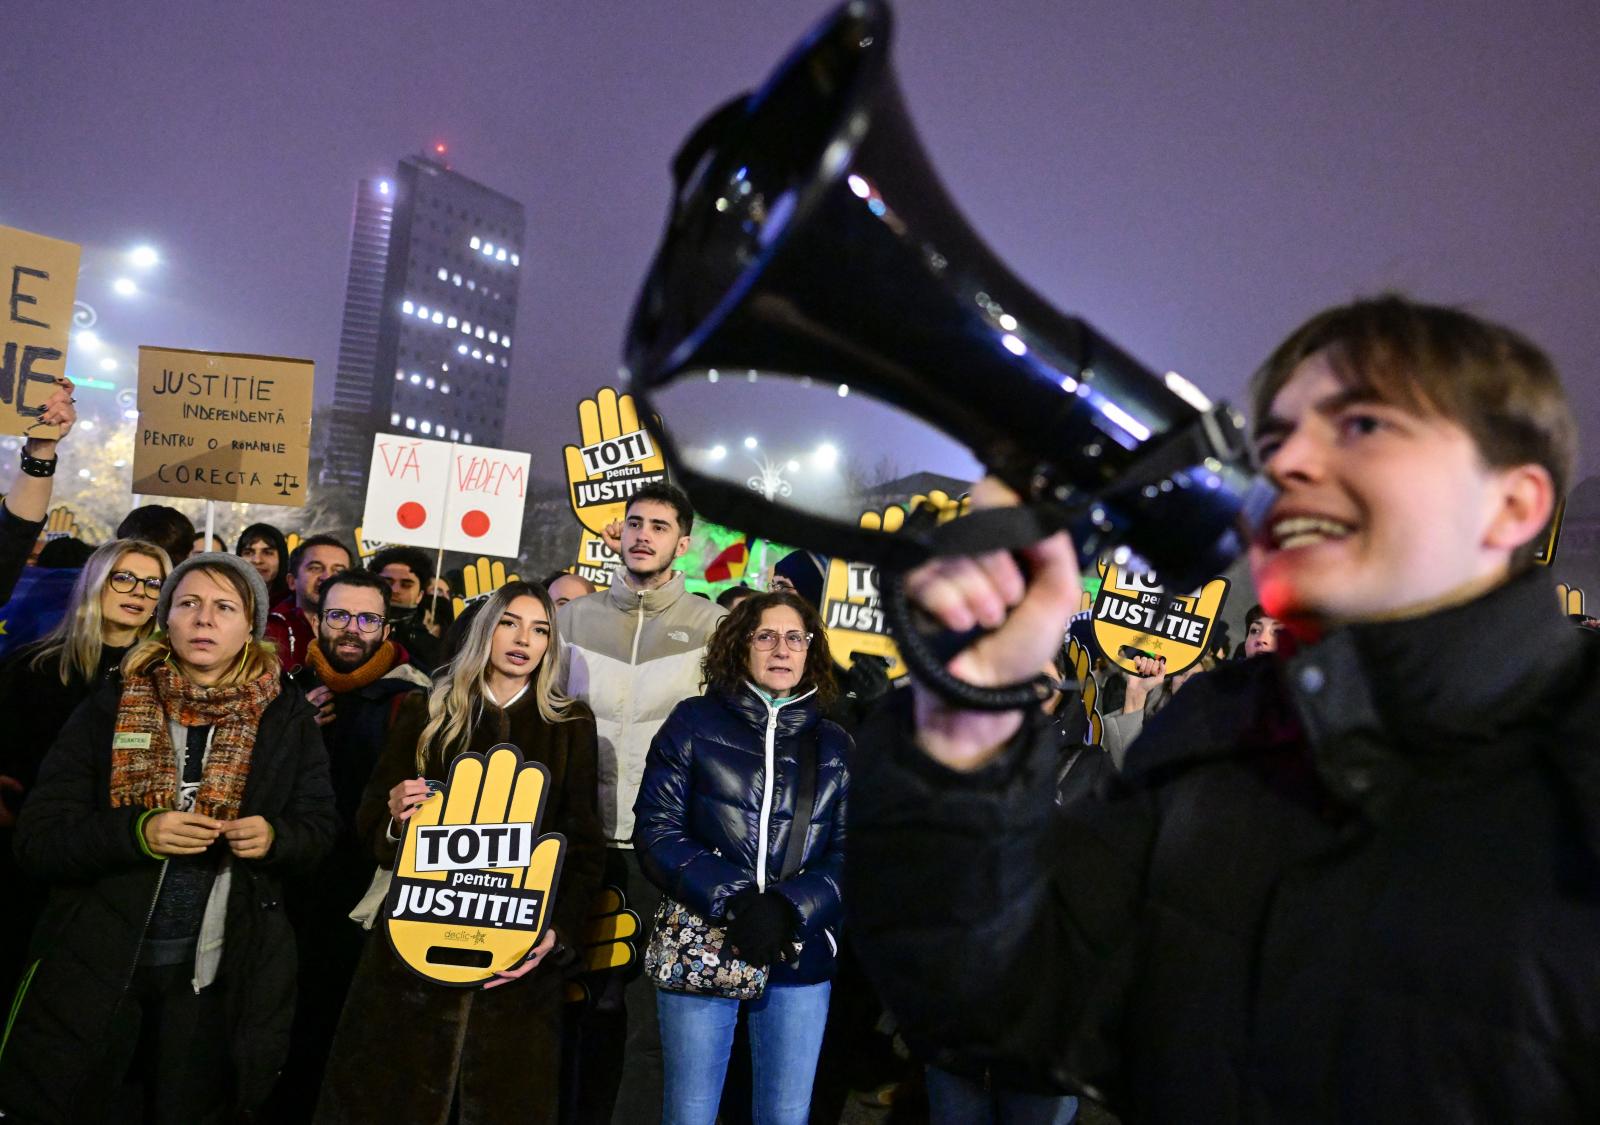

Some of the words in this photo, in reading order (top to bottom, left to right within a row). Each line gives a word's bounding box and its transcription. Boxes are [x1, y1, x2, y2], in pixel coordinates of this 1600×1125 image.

[10, 265, 50, 329] E
[144, 430, 195, 447] PENTRU
[208, 438, 218, 450] O
[583, 433, 647, 463] TOȚI
[158, 464, 262, 486] CORECTA
[457, 455, 524, 498] VEDEM
[606, 466, 641, 481] pentru
[420, 827, 522, 867] TOȚI
[452, 872, 508, 889] pentru
[392, 884, 538, 927] JUSTIȚIE
